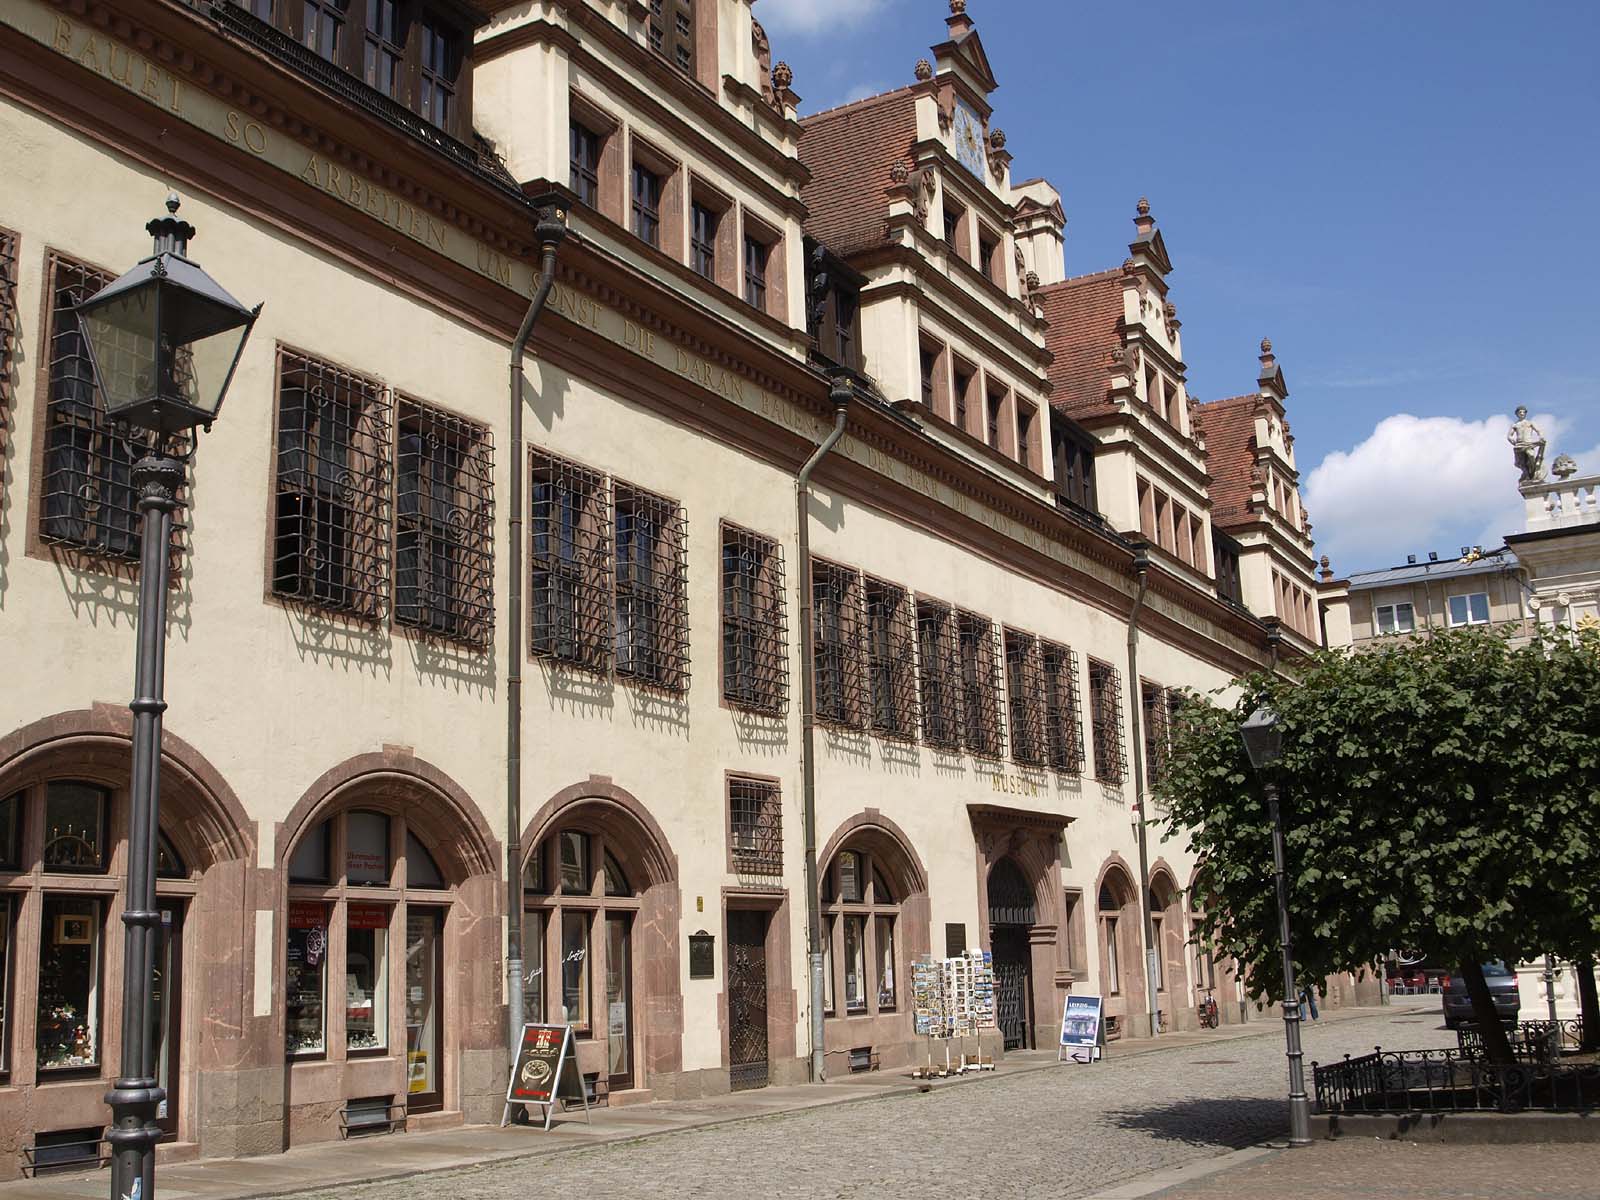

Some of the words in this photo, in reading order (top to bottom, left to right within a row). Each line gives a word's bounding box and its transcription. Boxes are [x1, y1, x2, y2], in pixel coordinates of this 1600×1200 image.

[223, 110, 269, 154] SO
[300, 152, 448, 251] ARBEITEN
[623, 319, 656, 359] DIE
[675, 347, 746, 402] DARAN
[992, 771, 1038, 798] MUSEUM
